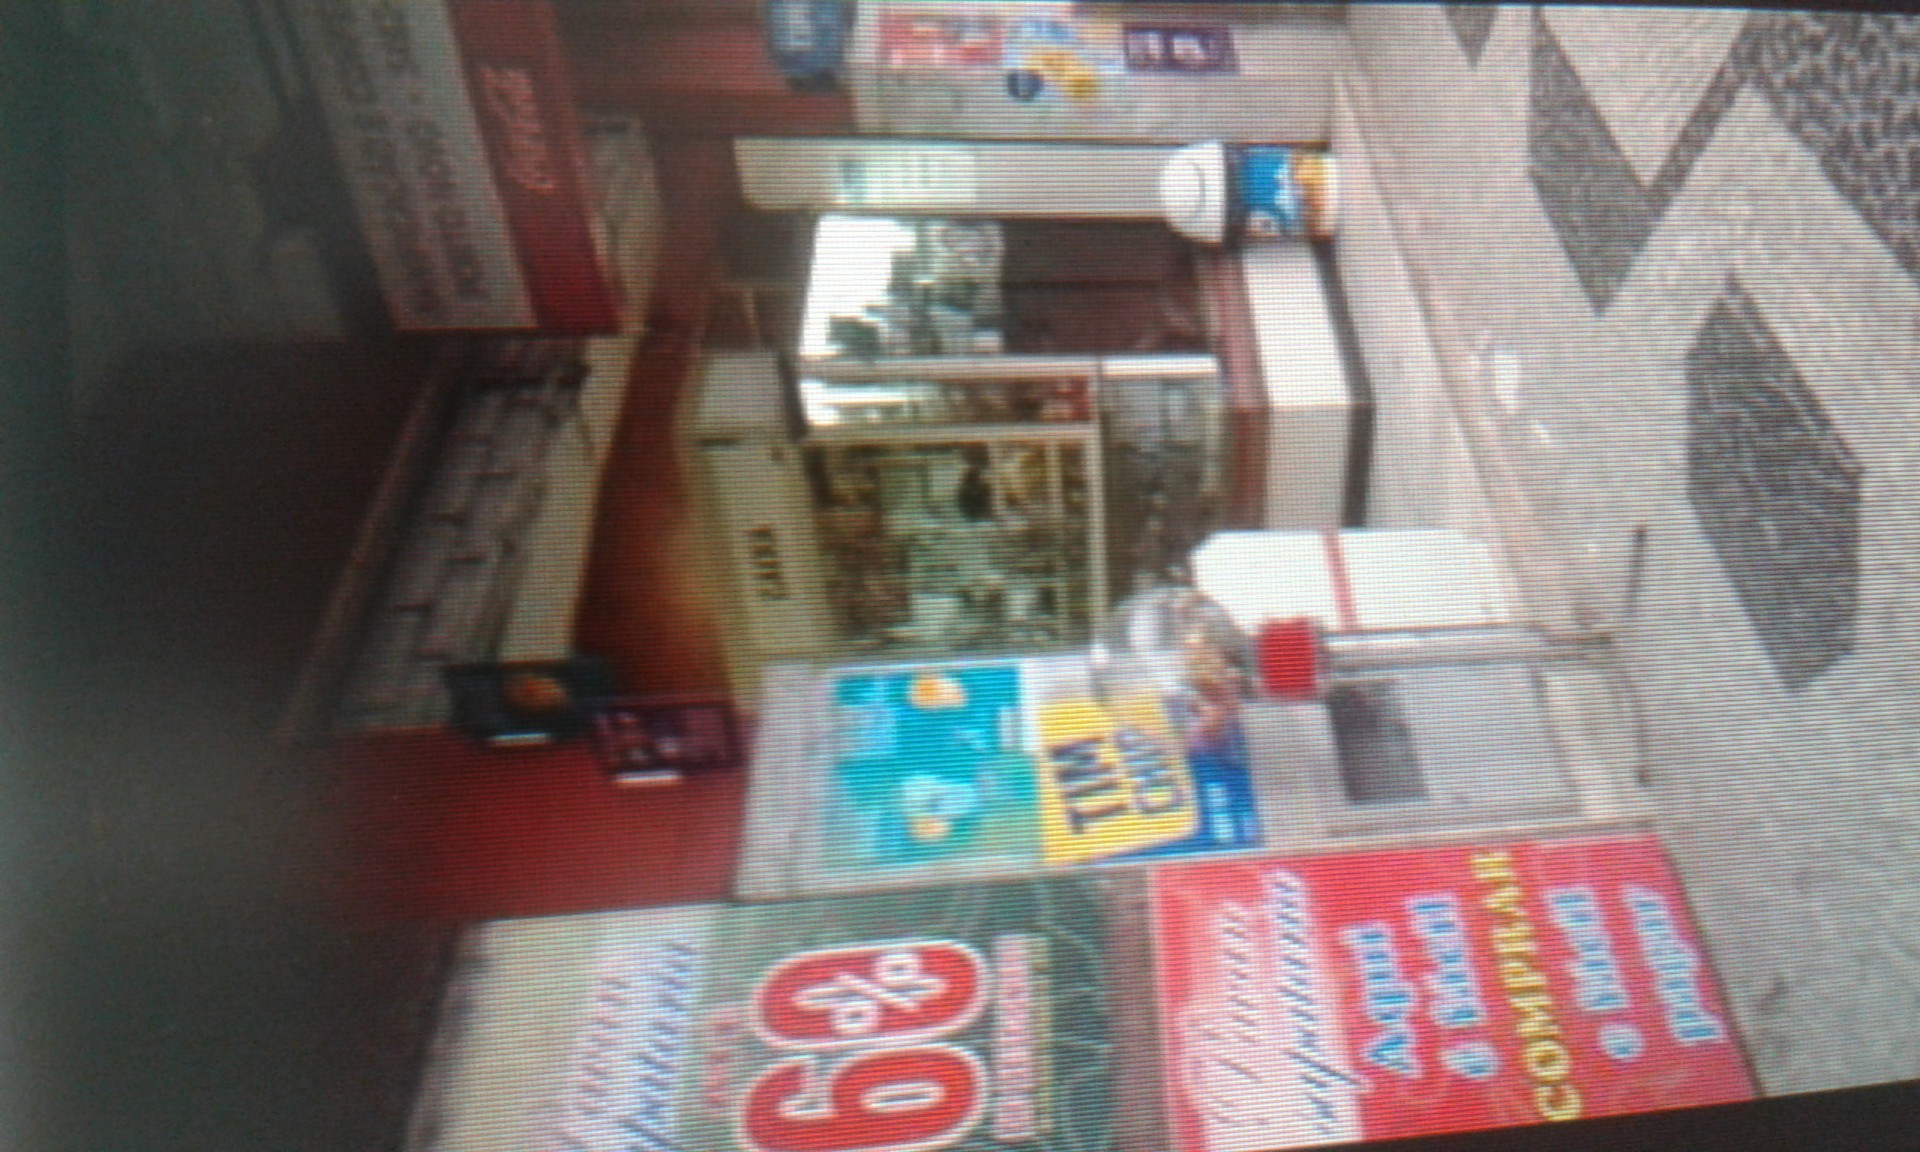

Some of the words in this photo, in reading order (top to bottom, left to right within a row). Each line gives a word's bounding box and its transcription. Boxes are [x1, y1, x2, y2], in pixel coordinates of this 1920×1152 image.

[750, 525, 787, 601] CAIXA
[1050, 734, 1126, 834] TIM
[1114, 728, 1180, 814] CHIP
[1342, 922, 1421, 1076] Aqui
[1471, 852, 1583, 1121] COMPRAR
[1621, 885, 1724, 1044] pagar
